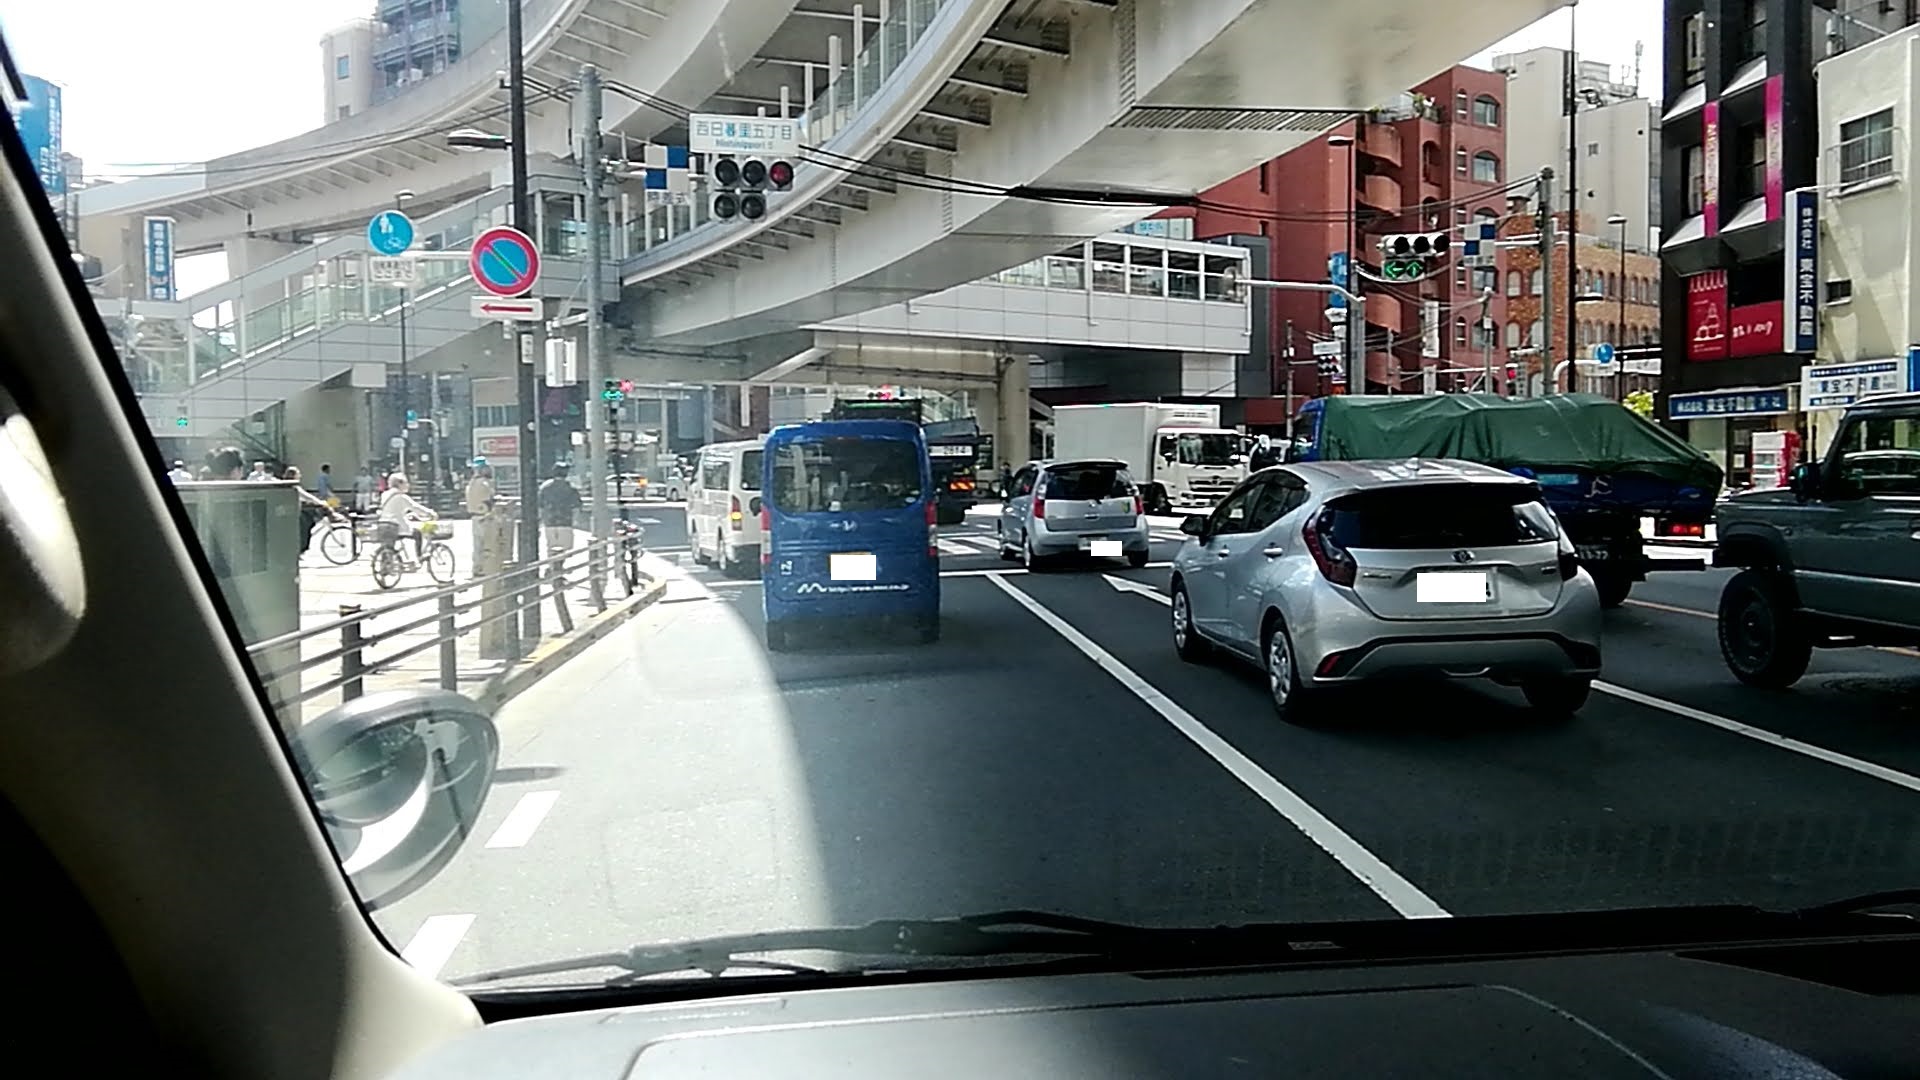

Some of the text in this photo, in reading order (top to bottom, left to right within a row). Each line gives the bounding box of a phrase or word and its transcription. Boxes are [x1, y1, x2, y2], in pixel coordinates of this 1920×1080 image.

[696, 120, 792, 140] 西日暮里五丁目
[1800, 207, 1814, 336] 株式会社 東宝不動産
